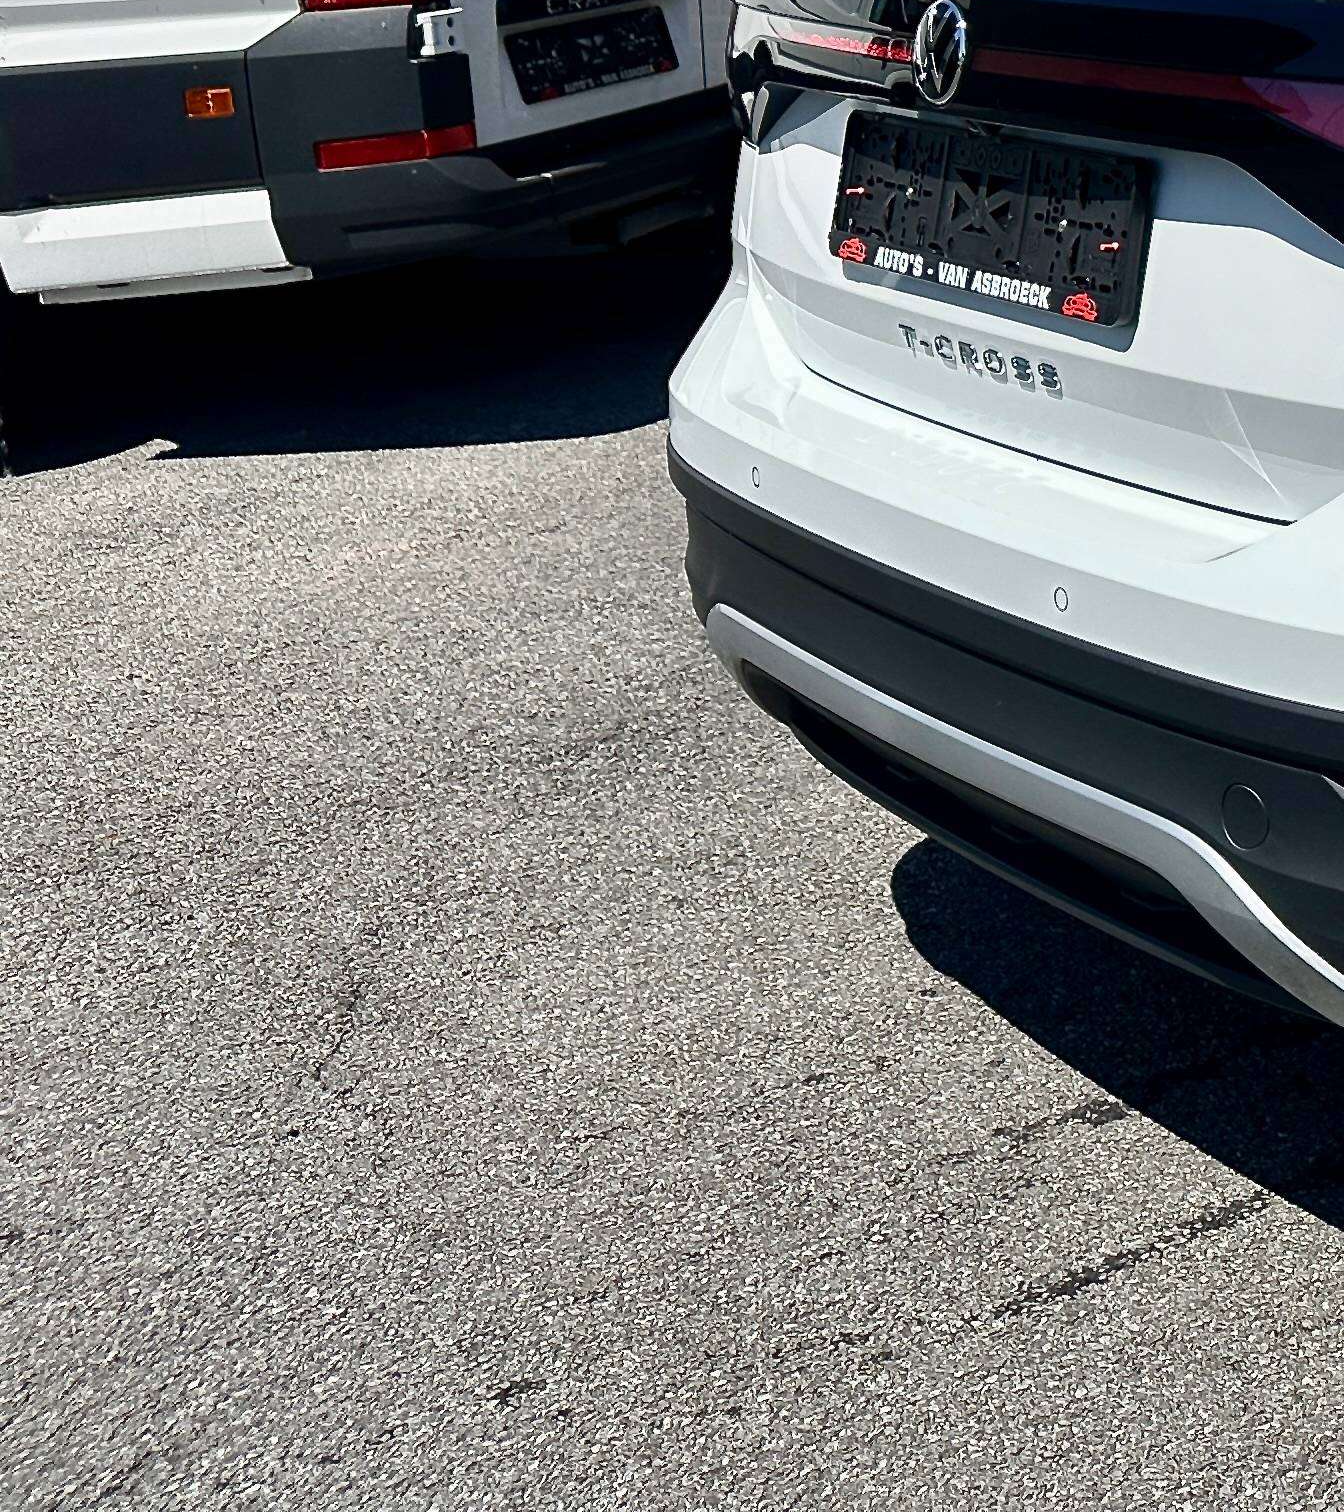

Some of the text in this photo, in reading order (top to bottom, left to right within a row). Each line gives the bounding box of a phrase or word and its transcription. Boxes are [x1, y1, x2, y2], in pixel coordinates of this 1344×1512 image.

[873, 245, 1052, 310] AUTO'S VAN ASBROECK
[898, 323, 1062, 391] T-CROSS
